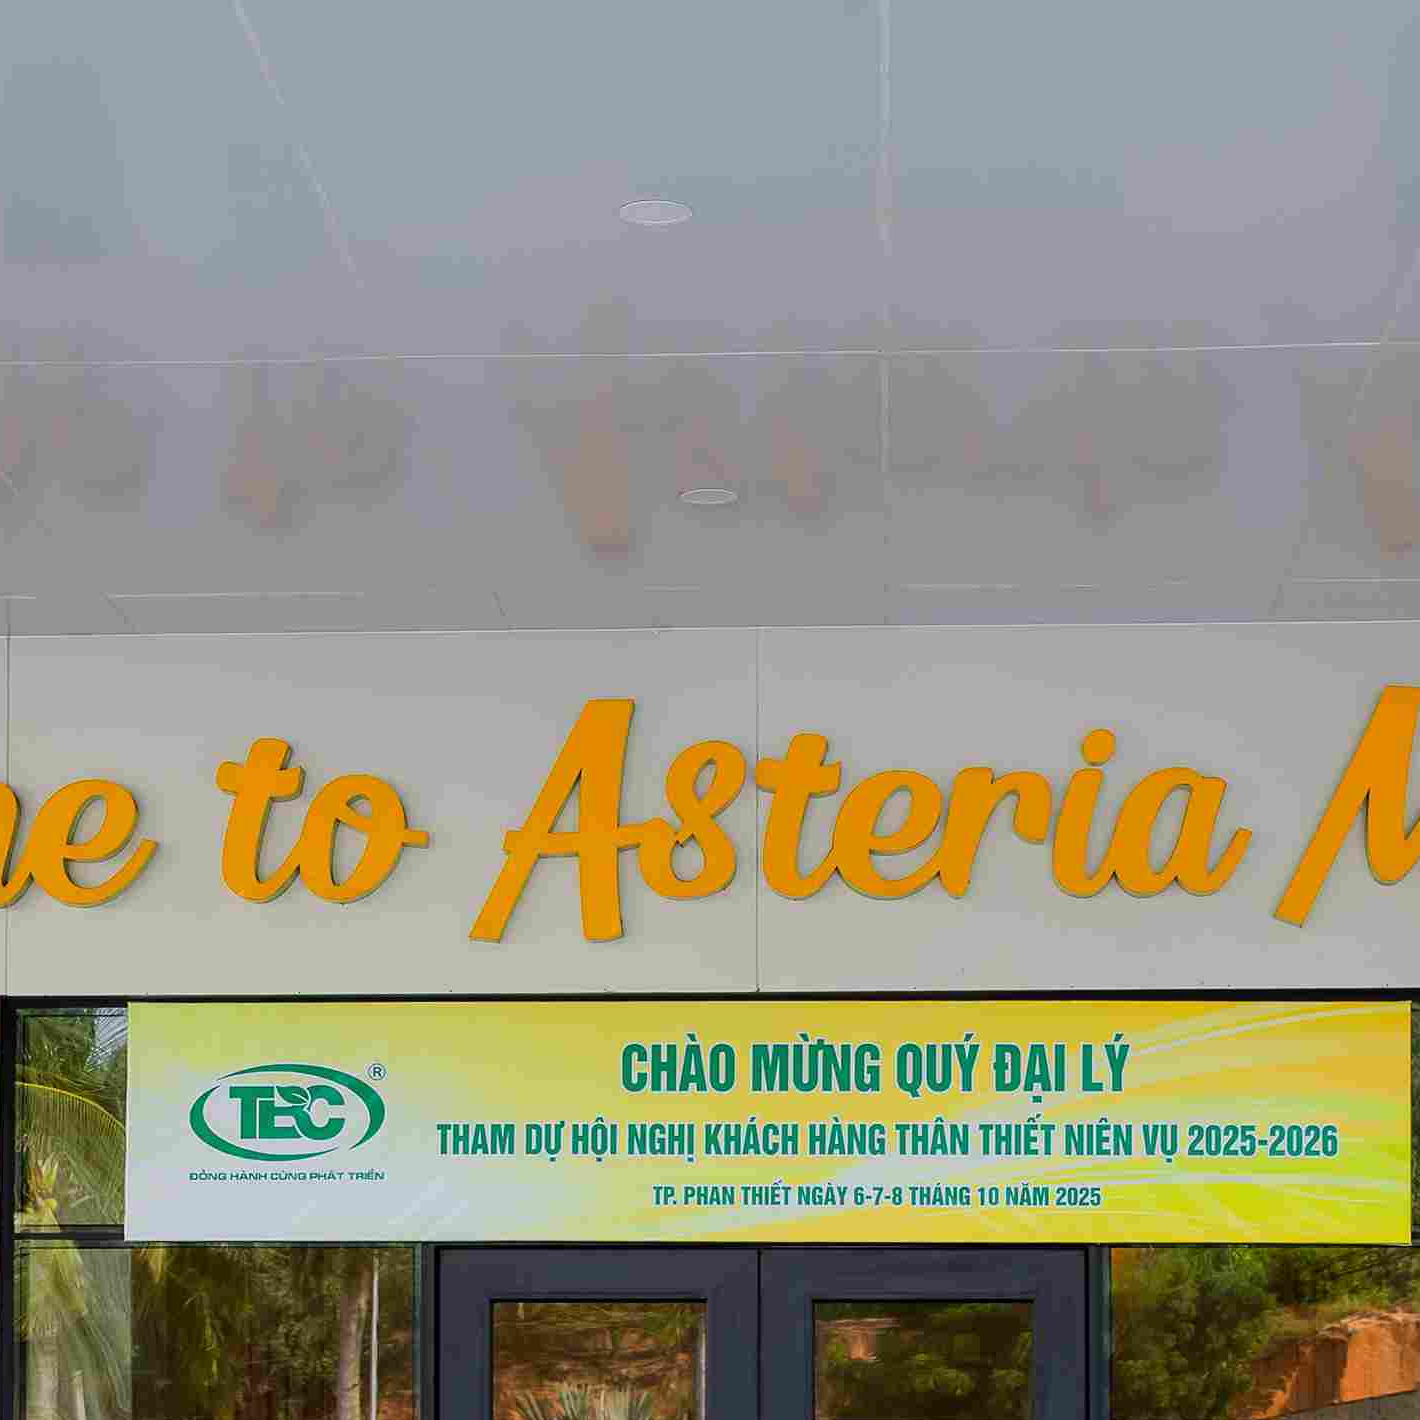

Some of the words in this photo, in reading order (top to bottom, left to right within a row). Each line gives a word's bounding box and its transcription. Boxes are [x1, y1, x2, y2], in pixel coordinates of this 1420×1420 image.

[216, 737, 430, 903] to
[469, 698, 1253, 942] Asteria
[623, 1033, 736, 1092] CHÀO
[752, 1033, 880, 1092] MỪNG
[896, 1034, 980, 1097] QUÝ
[994, 1044, 1065, 1103] ĐẠI
[1082, 1033, 1130, 1092] LÝ
[436, 1123, 515, 1155] THAM
[525, 1122, 565, 1162] DỰ
[572, 1117, 618, 1162] HỘI
[627, 1123, 695, 1162] NGHỊ
[704, 1117, 799, 1155] KHÁCH
[808, 1117, 885, 1155] HÀNG
[895, 1116, 969, 1155] THÂN
[979, 1114, 1056, 1156] THIẾT
[1065, 1117, 1133, 1156] NIÊN
[1142, 1124, 1178, 1163] VỤ
[1187, 1124, 1338, 1157] 2025-2026
[230, 1168, 267, 1181] HÀNH
[270, 1168, 306, 1181] CÙNG
[309, 1168, 344, 1181] PHÁT
[653, 1185, 677, 1206] TP.
[684, 1186, 735, 1206] PHAN
[741, 1180, 791, 1206] THIẾT
[797, 1182, 848, 1206] NGÀY
[854, 1186, 902, 1206] 6-7-8
[909, 1182, 970, 1206] THÁNG
[978, 1186, 999, 1206] 10
[1006, 1182, 1051, 1206] NĂM
[1056, 1186, 1101, 1206] 2025
